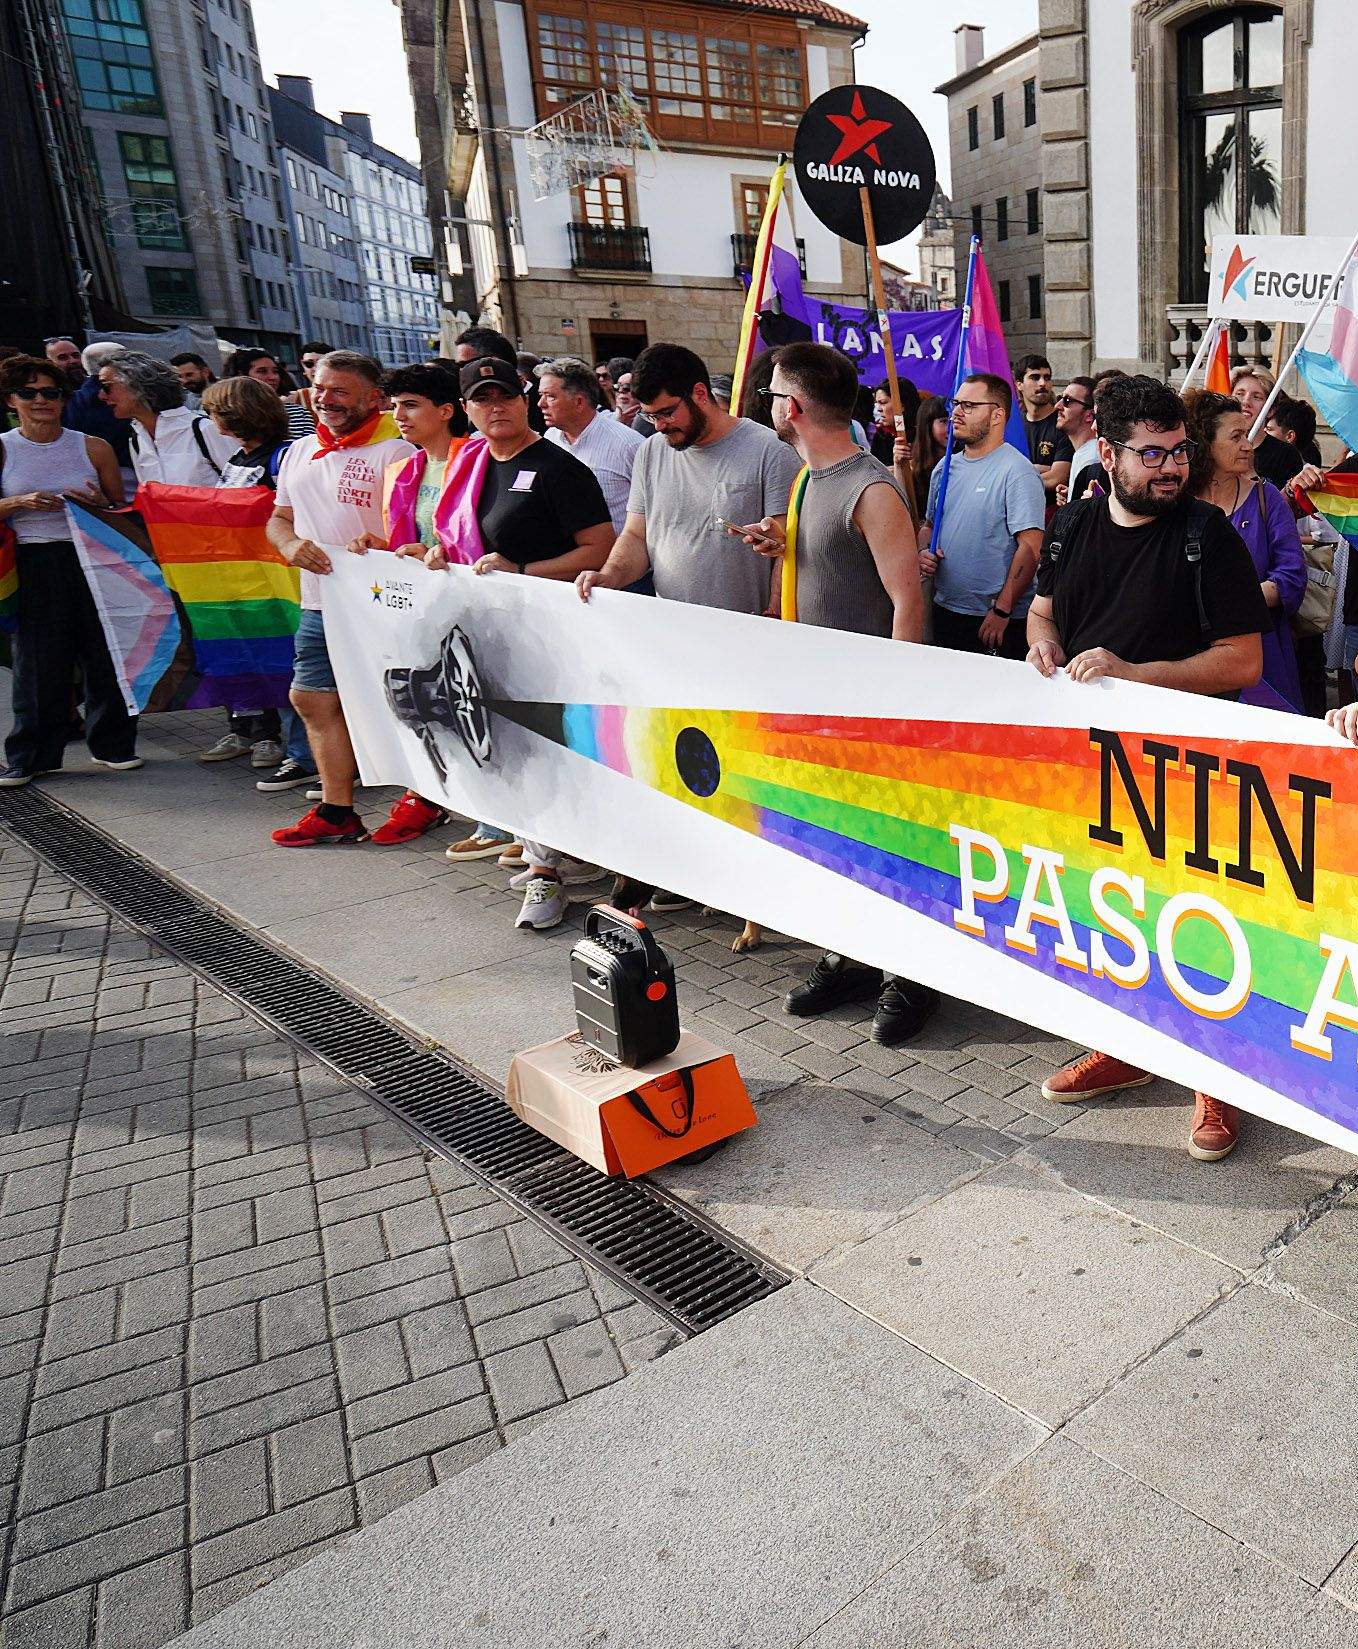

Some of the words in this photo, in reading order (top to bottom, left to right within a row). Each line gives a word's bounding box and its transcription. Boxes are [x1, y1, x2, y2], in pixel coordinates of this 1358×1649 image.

[806, 161, 865, 184] GALIZA
[873, 169, 920, 190] NOVA
[347, 457, 366, 465] LES
[1089, 727, 1331, 908] NIN
[948, 823, 1252, 1020] PASO
